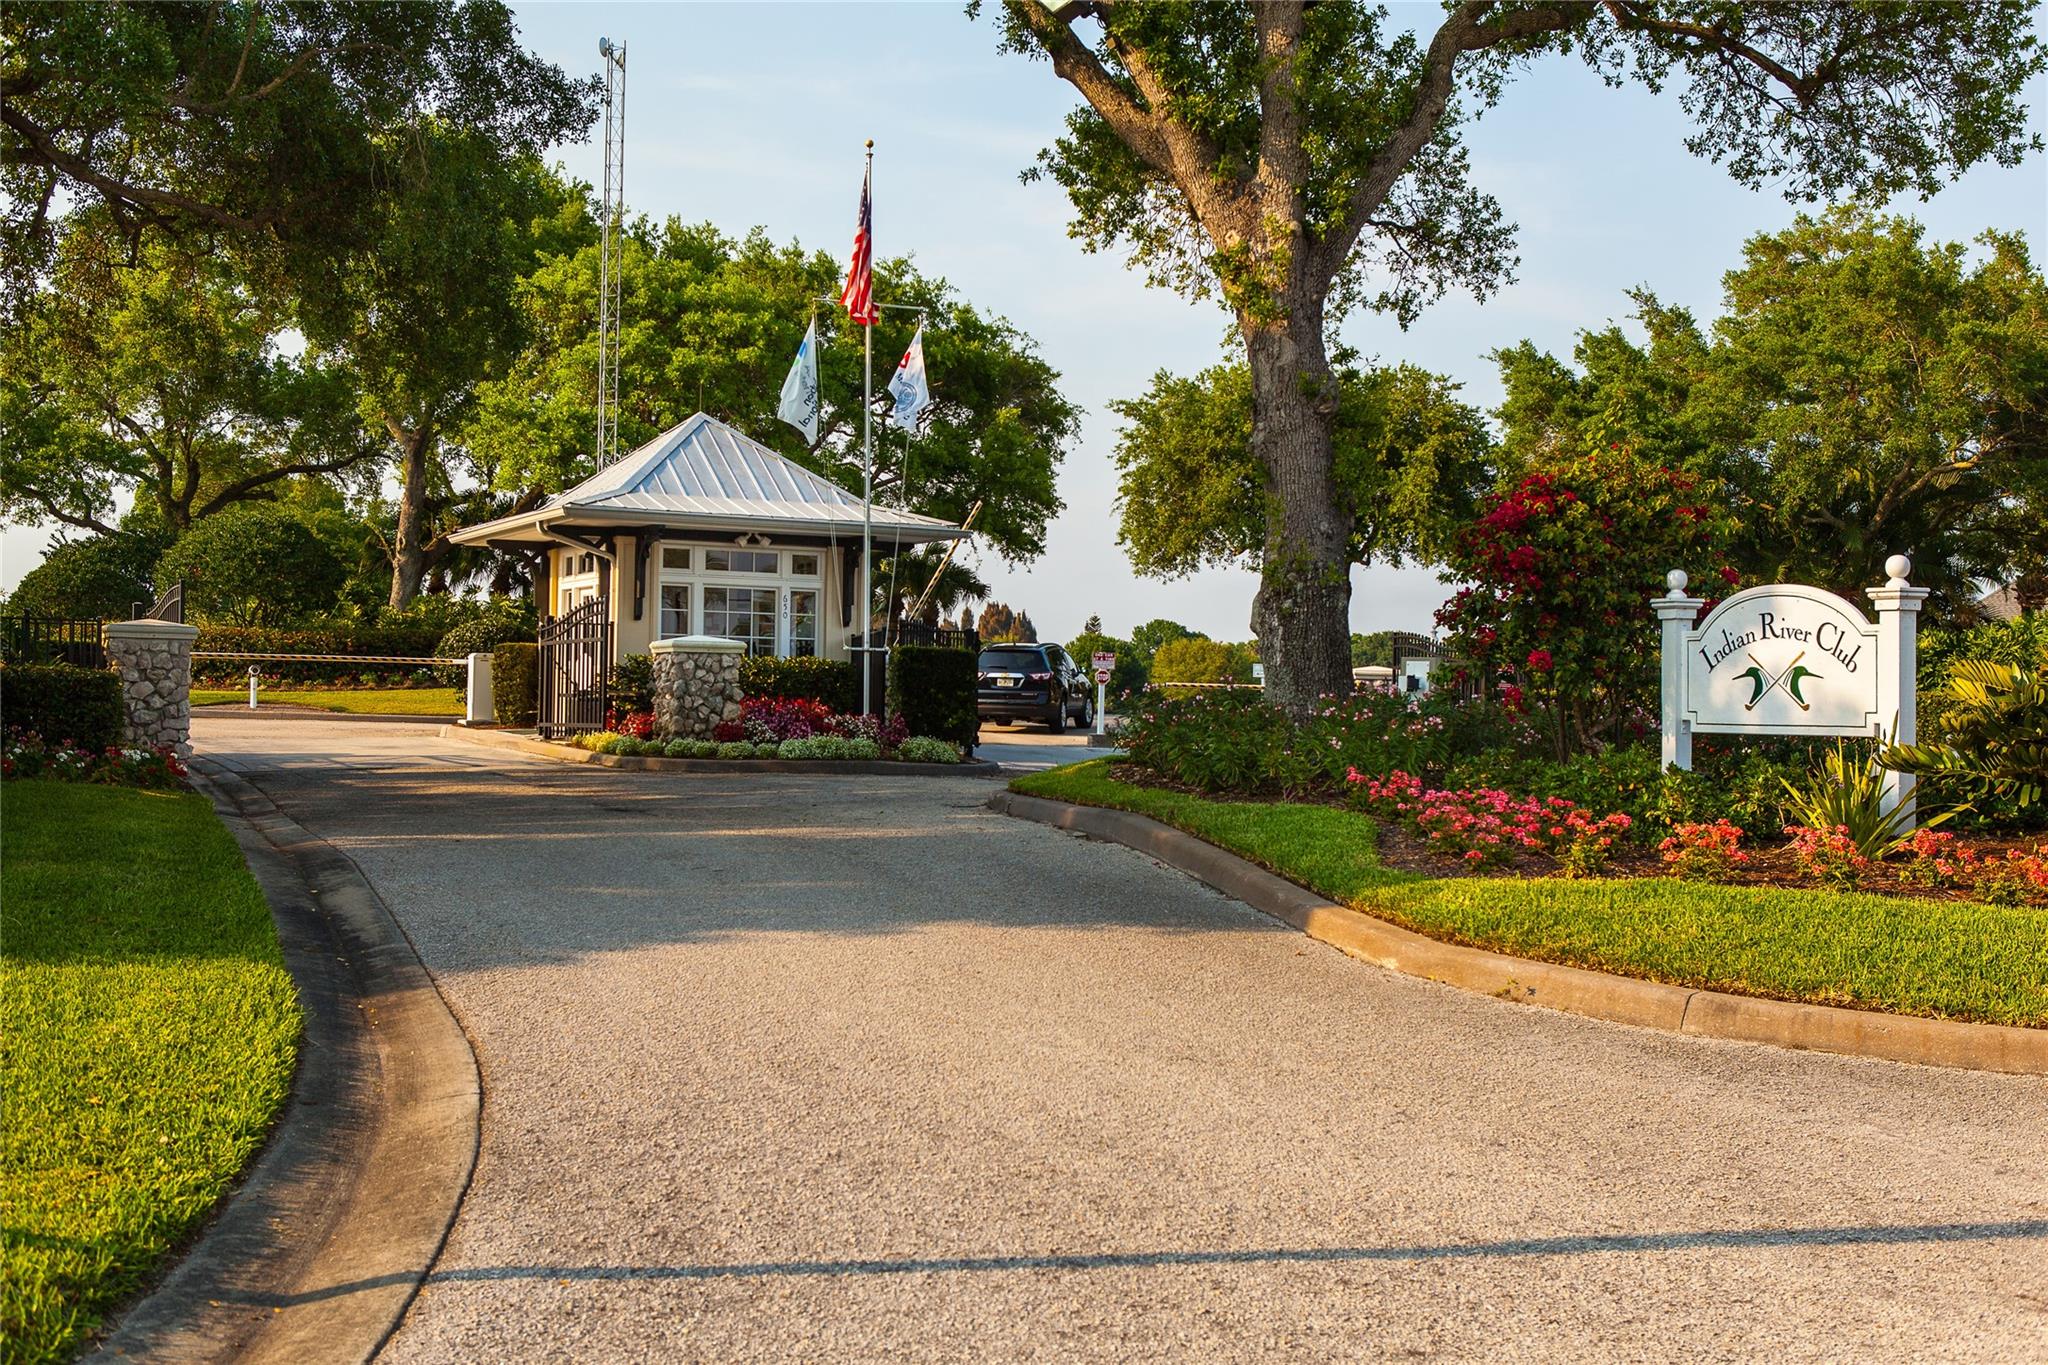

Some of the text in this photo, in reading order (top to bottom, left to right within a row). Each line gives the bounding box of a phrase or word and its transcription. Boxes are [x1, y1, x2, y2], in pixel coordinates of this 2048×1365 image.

[1699, 612, 1862, 674] Indian River Club
